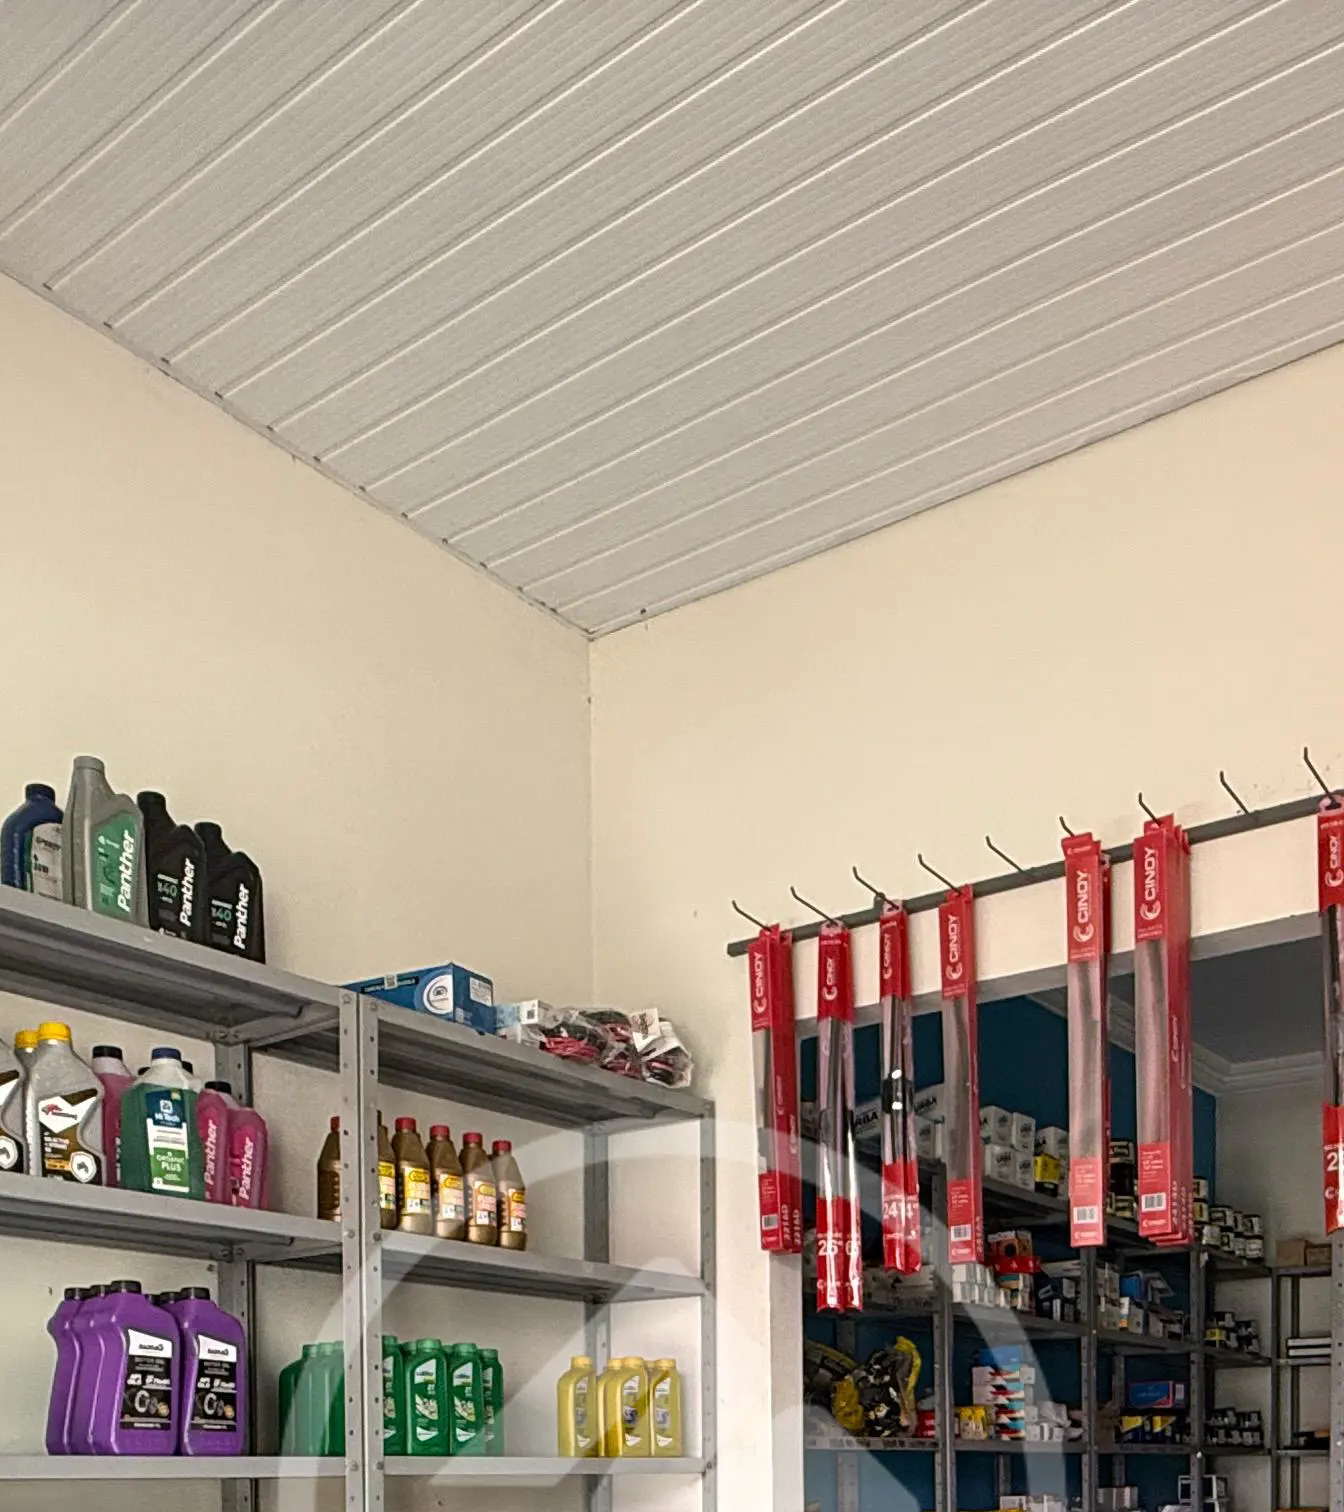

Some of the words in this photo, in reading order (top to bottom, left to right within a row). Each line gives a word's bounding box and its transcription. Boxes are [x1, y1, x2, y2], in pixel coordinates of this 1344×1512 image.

[118, 830, 136, 912] Panther
[180, 857, 196, 927] Panther
[1076, 870, 1090, 924] CINDY
[1143, 847, 1158, 900] CINDY
[234, 883, 250, 949] Panther
[947, 914, 961, 963] CINDY
[161, 1161, 182, 1171] PLUS
[204, 1119, 219, 1185] Panther
[239, 1137, 255, 1200] Panther
